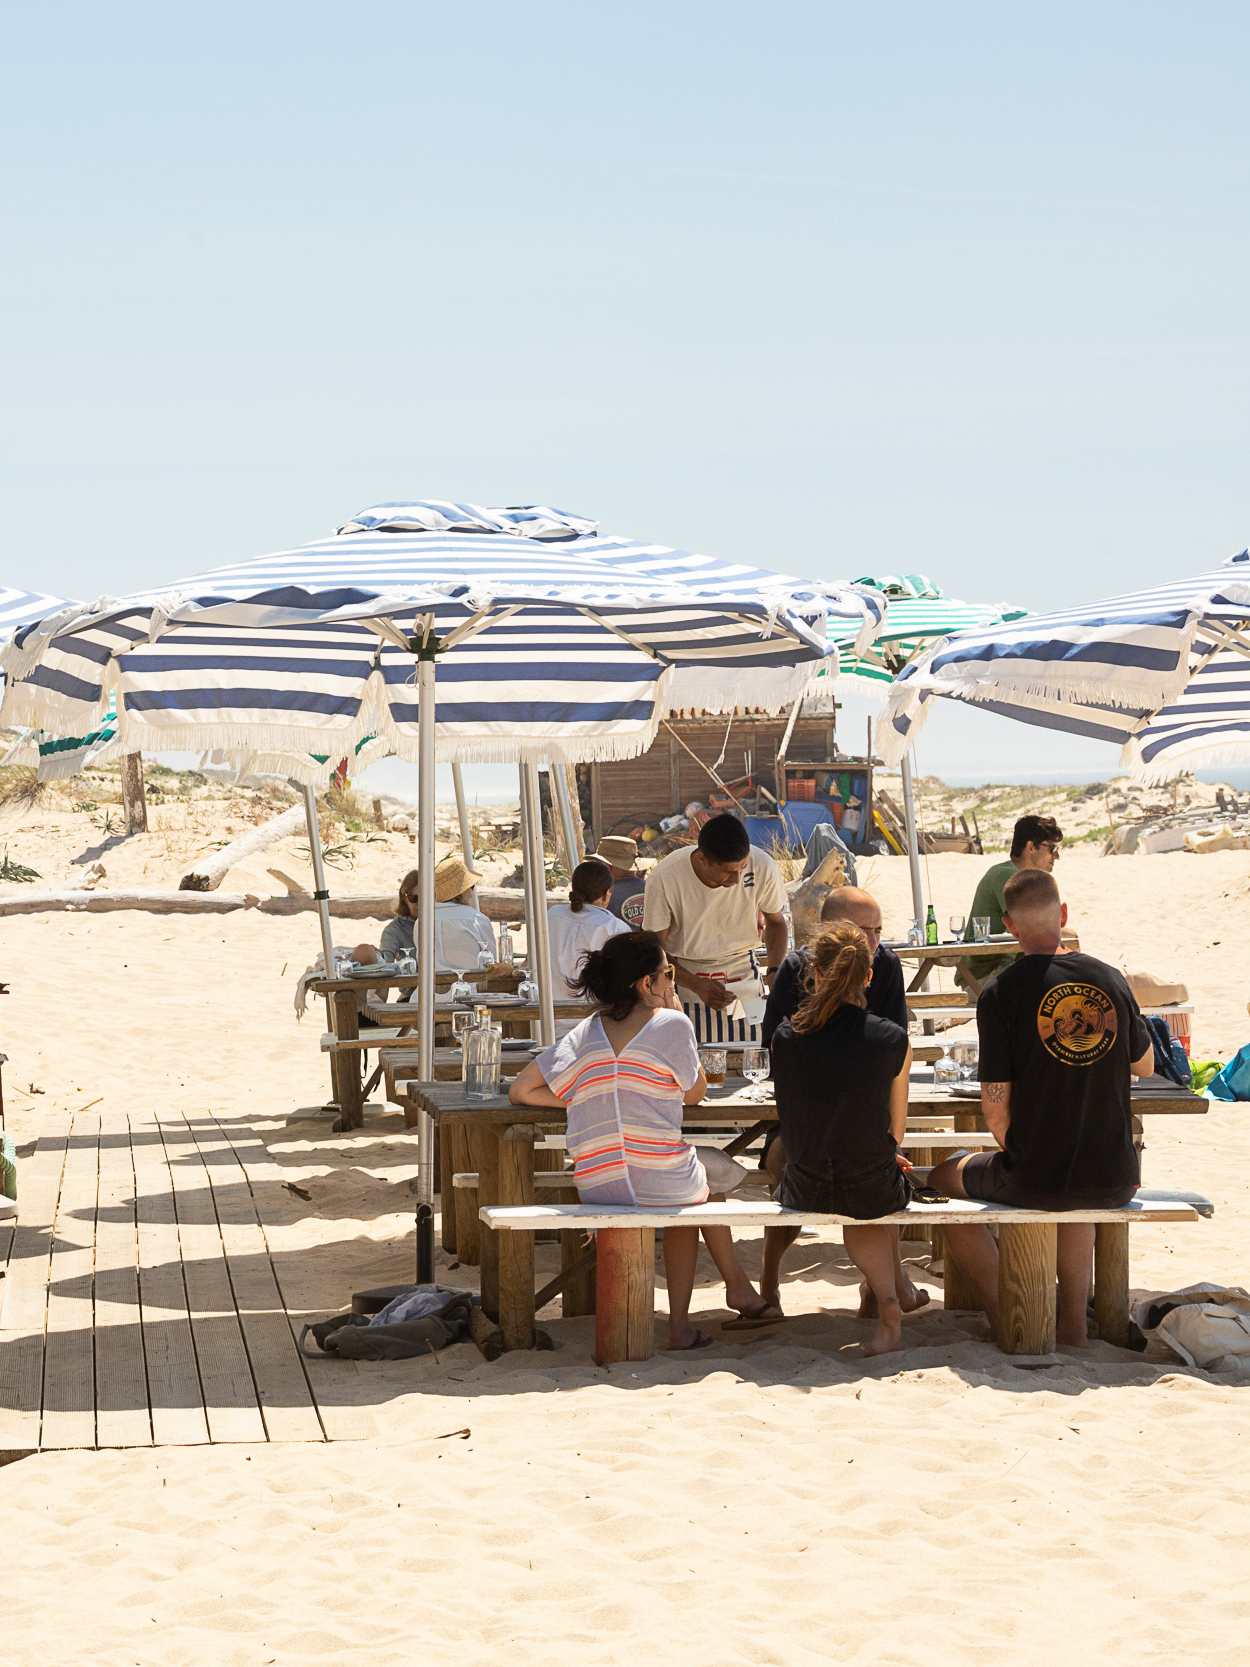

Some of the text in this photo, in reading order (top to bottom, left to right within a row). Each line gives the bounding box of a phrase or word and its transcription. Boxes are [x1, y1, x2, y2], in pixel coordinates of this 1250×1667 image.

[627, 907, 639, 918] OLD
[1043, 986, 1109, 1014] NORTH OCEAN
[1099, 1037, 1110, 1051] PARK
